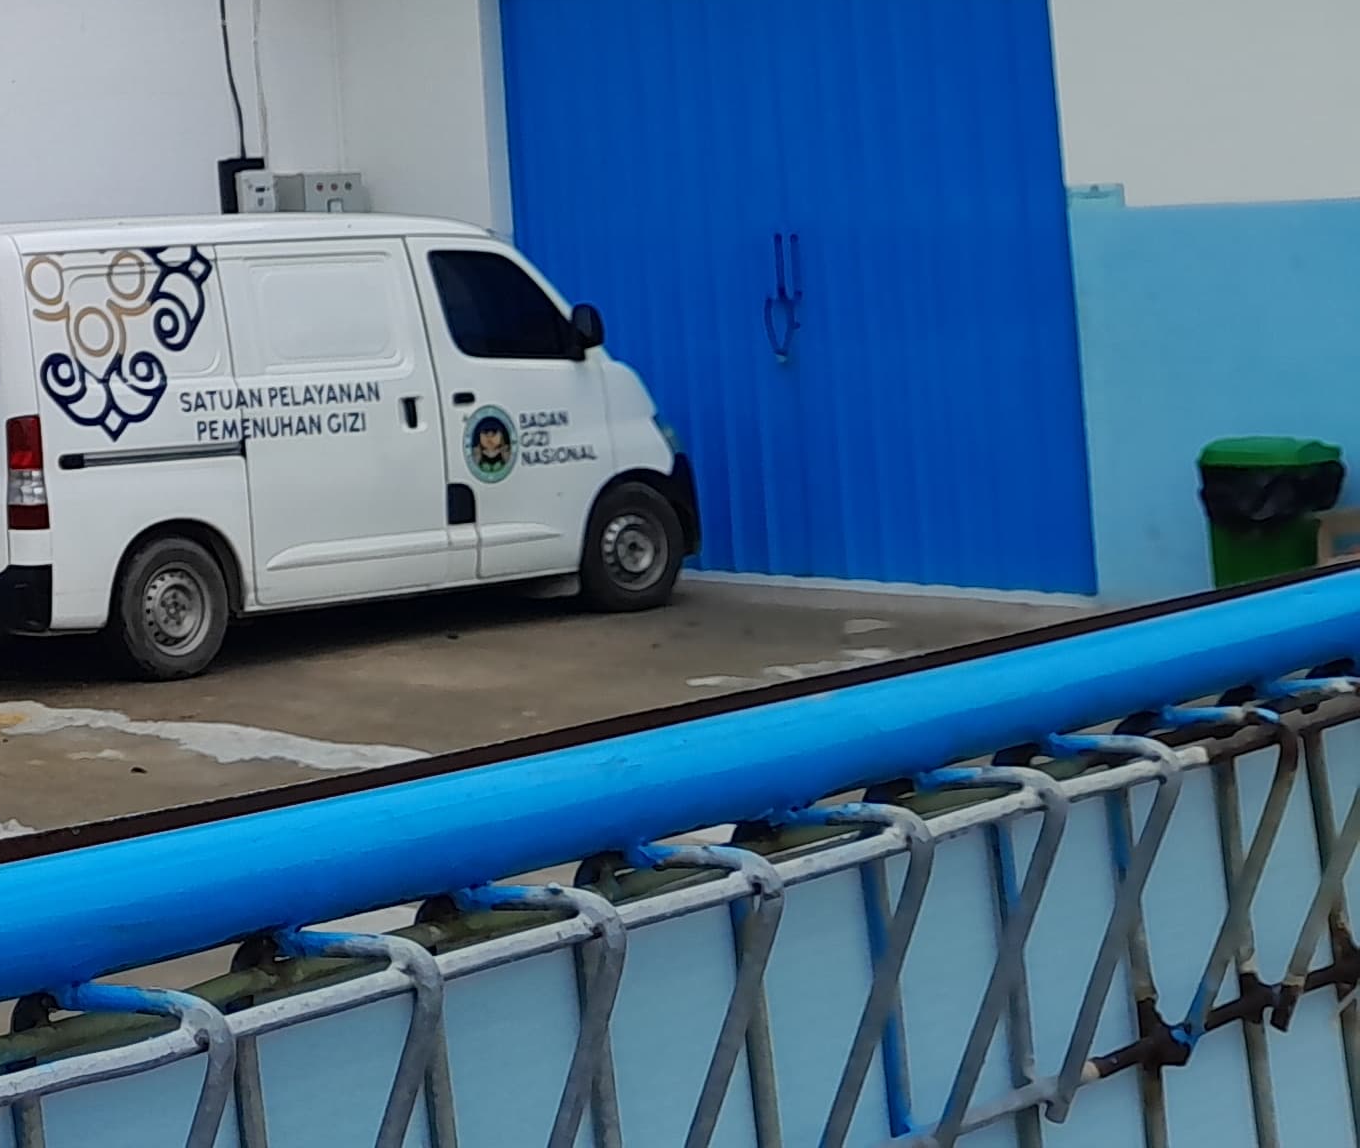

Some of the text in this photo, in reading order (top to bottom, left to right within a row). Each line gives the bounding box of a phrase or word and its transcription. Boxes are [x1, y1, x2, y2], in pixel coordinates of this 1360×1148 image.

[179, 380, 381, 413] SATUAN PELAYANAN
[196, 412, 367, 442] PEMENUHAN GIZI
